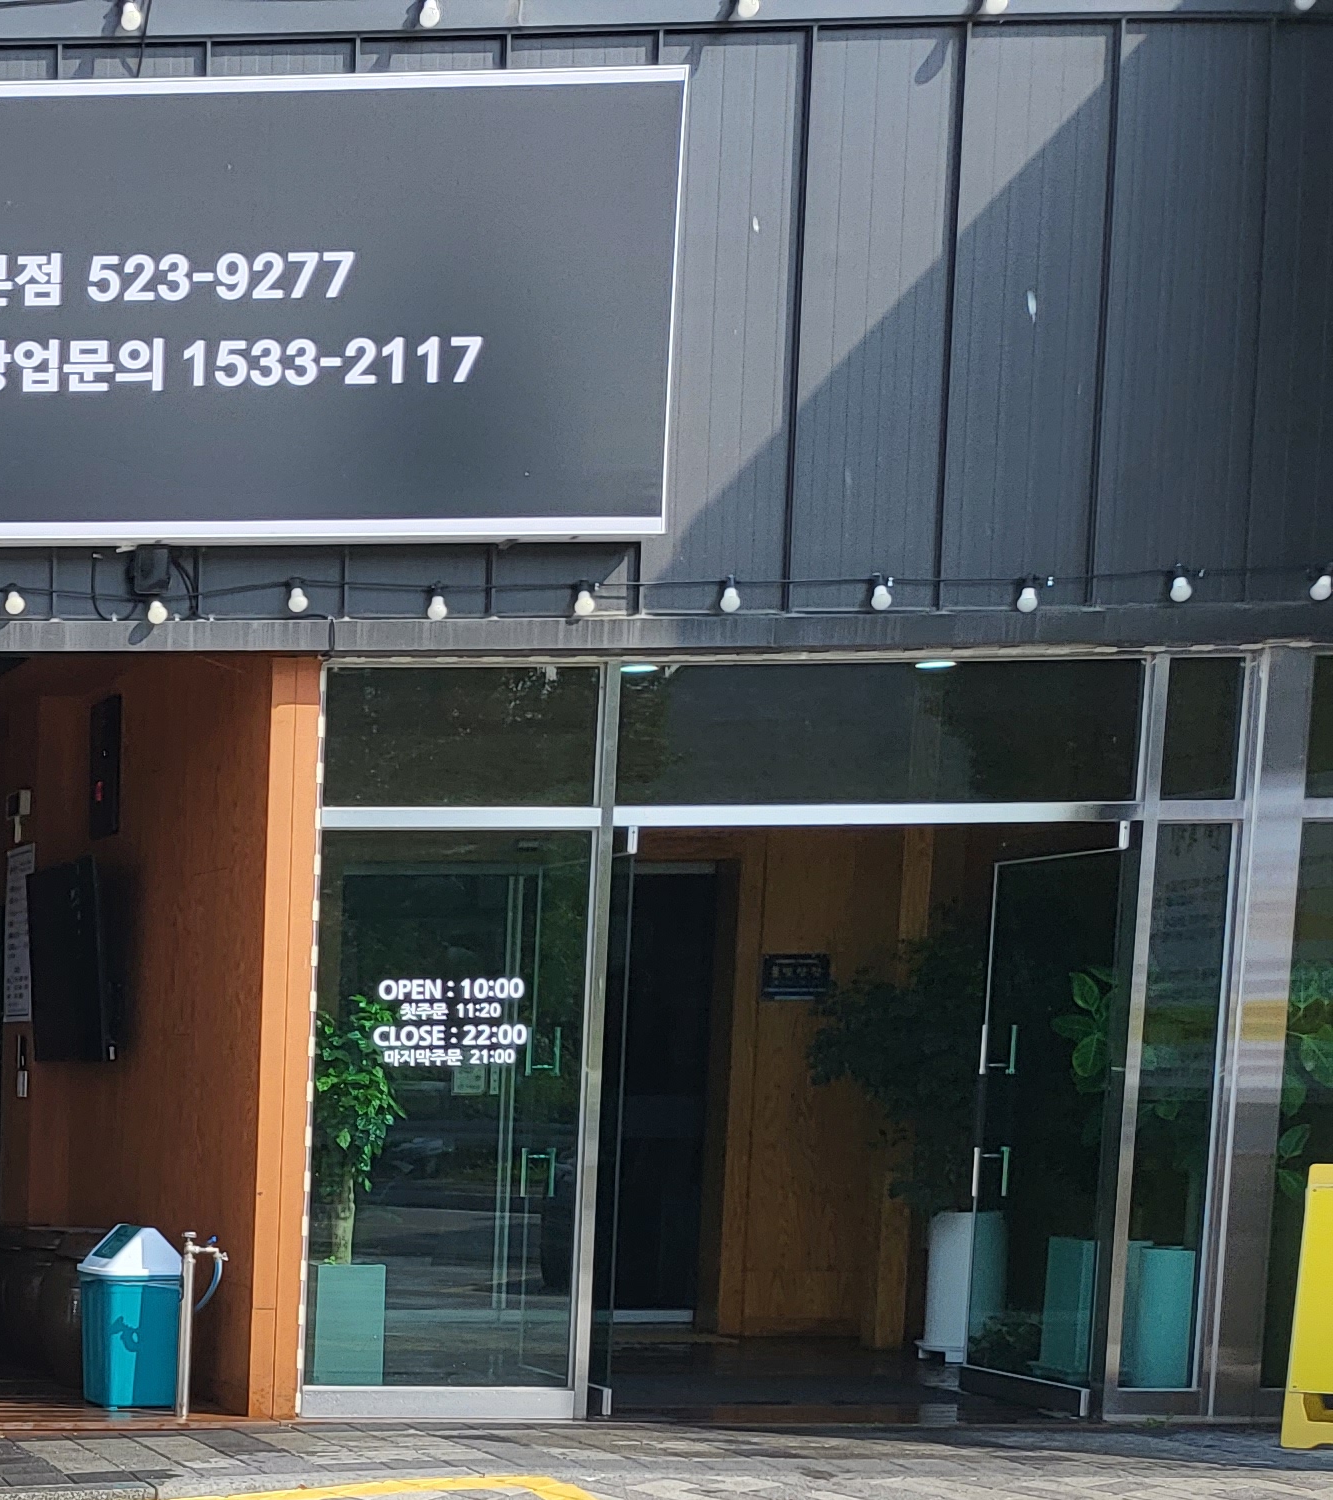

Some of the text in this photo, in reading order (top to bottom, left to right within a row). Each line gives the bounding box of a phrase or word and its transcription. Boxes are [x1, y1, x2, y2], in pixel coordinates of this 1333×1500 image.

[86, 250, 356, 302] 523-9277
[181, 335, 483, 388] 1533-2117
[378, 979, 443, 1000] OPEN
[460, 977, 525, 999] 10:00
[399, 1002, 502, 1021] 첫주문 11:20
[373, 1024, 446, 1047] CLOSE
[462, 1024, 528, 1046] 22:00
[383, 1049, 517, 1067] 마지막주문 21:00
